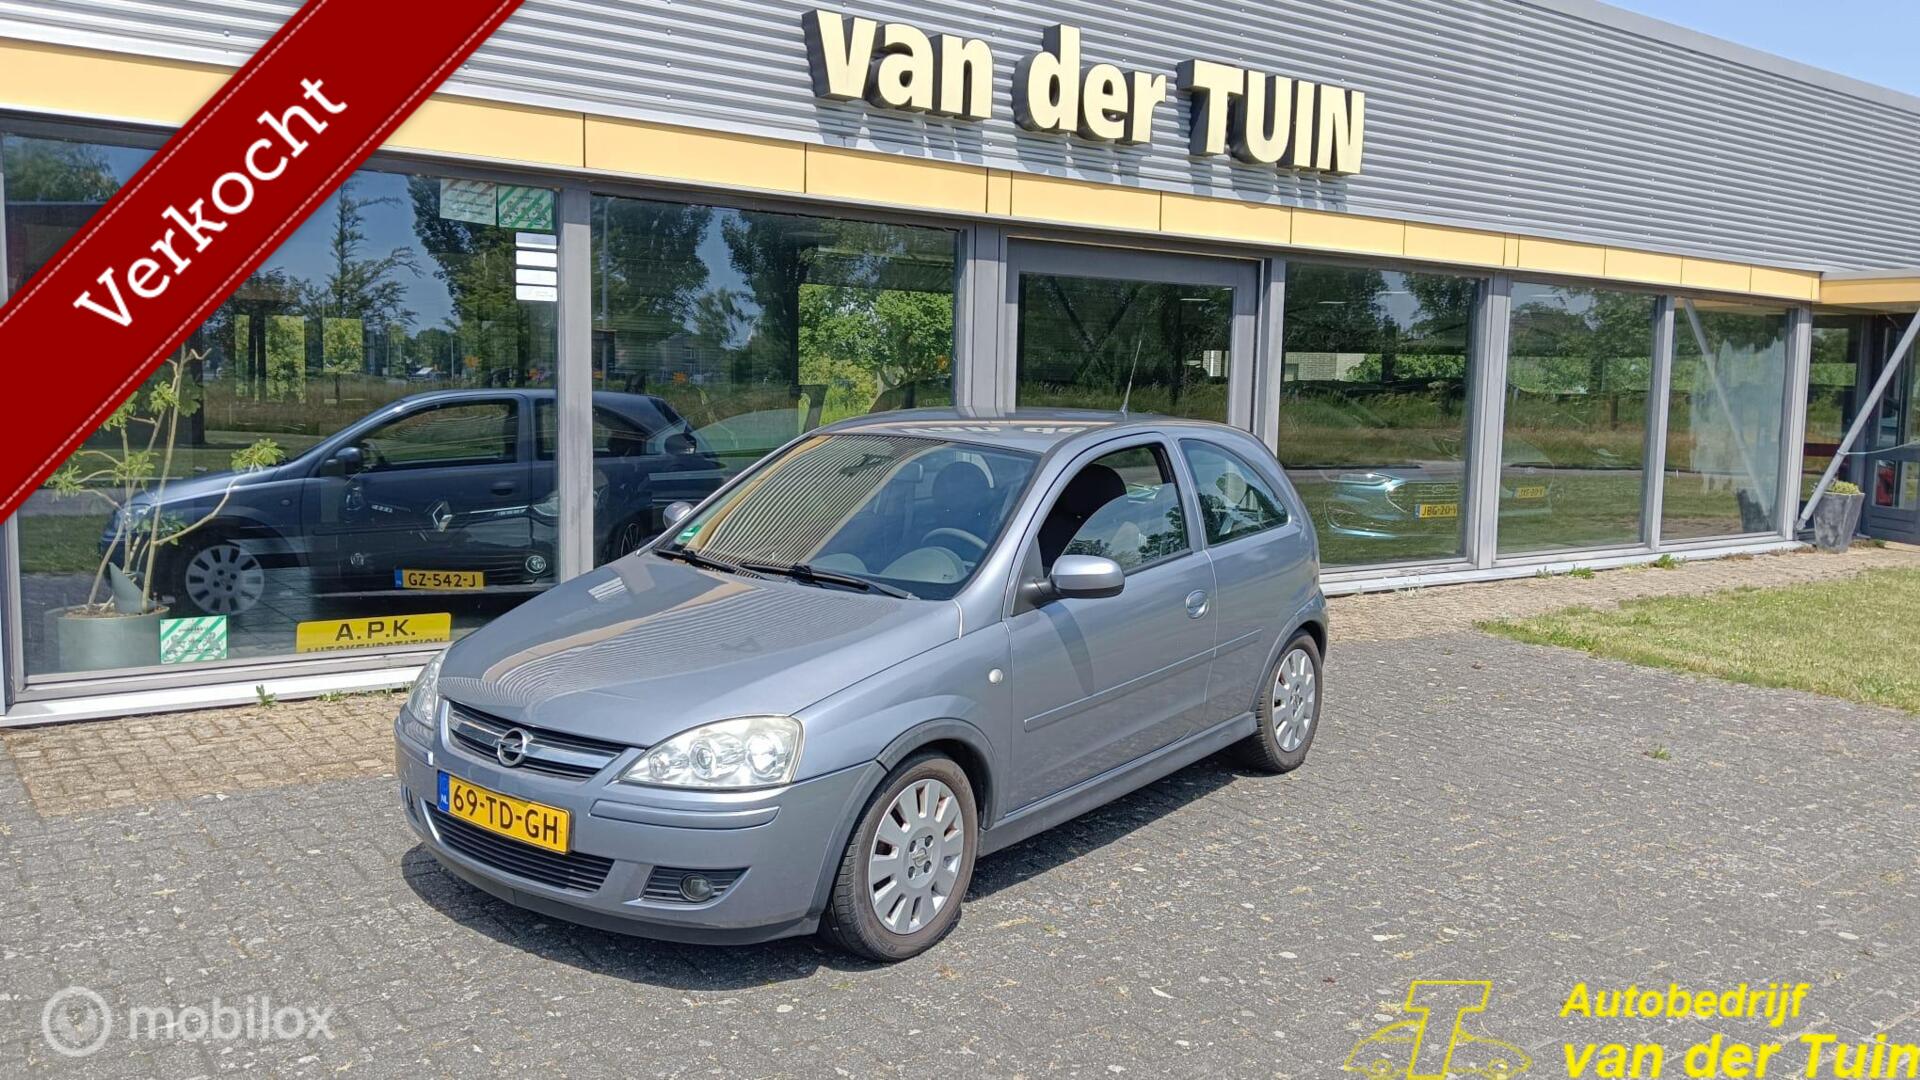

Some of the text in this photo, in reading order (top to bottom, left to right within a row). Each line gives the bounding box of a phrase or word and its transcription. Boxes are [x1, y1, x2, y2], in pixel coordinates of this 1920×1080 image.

[802, 9, 1366, 176] van der TUIN
[408, 572, 476, 588] GZ-542-J
[335, 619, 416, 642] A.P.K.
[440, 793, 449, 805] NL
[453, 784, 558, 845] 69-TD-GH
